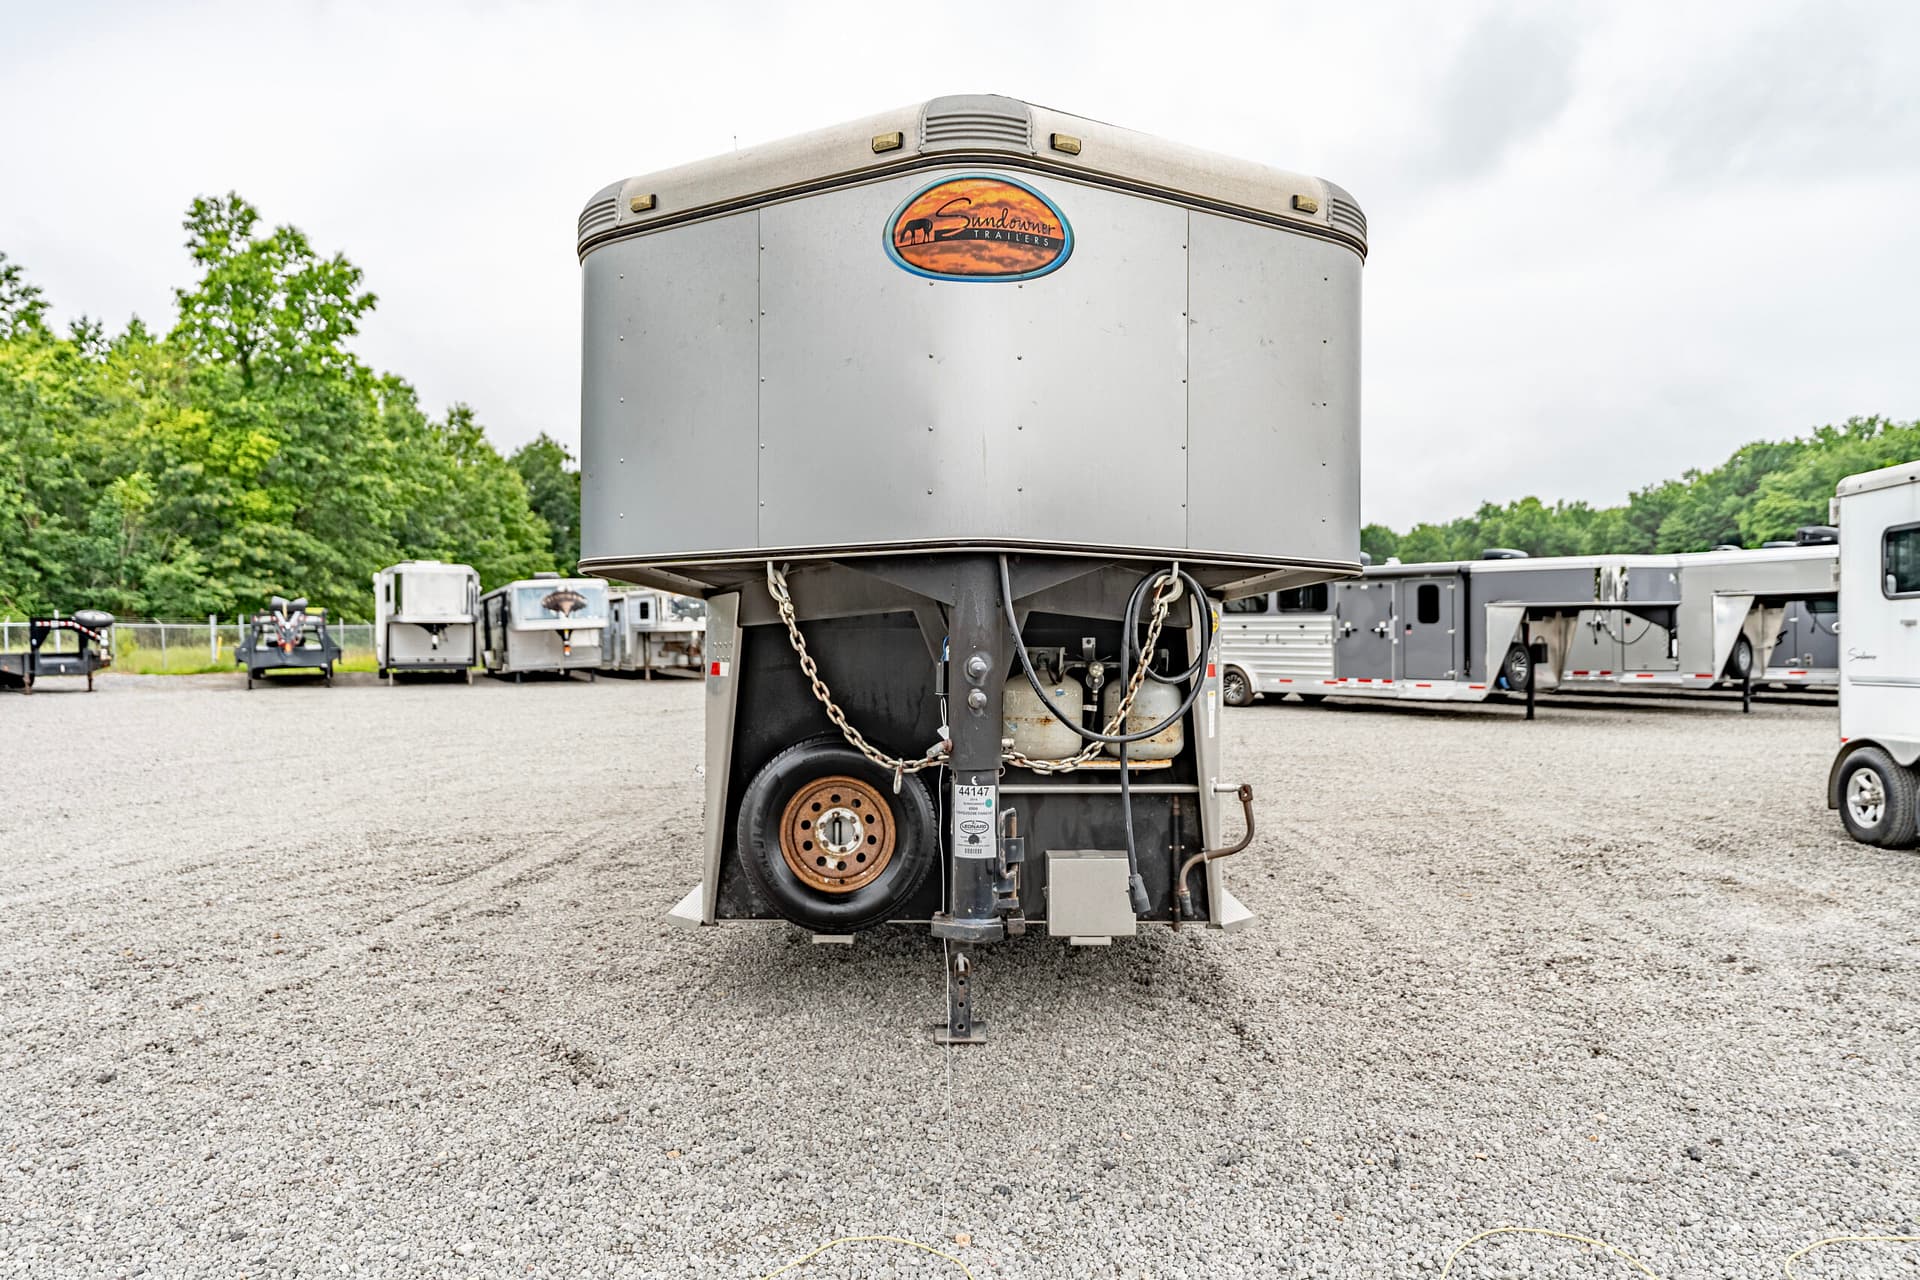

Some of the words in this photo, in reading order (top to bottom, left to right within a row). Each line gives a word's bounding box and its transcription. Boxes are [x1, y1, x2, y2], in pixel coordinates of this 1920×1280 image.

[935, 197, 1056, 237] Sundowner
[973, 229, 1049, 247] TRAILERS
[958, 787, 990, 797] 44147
